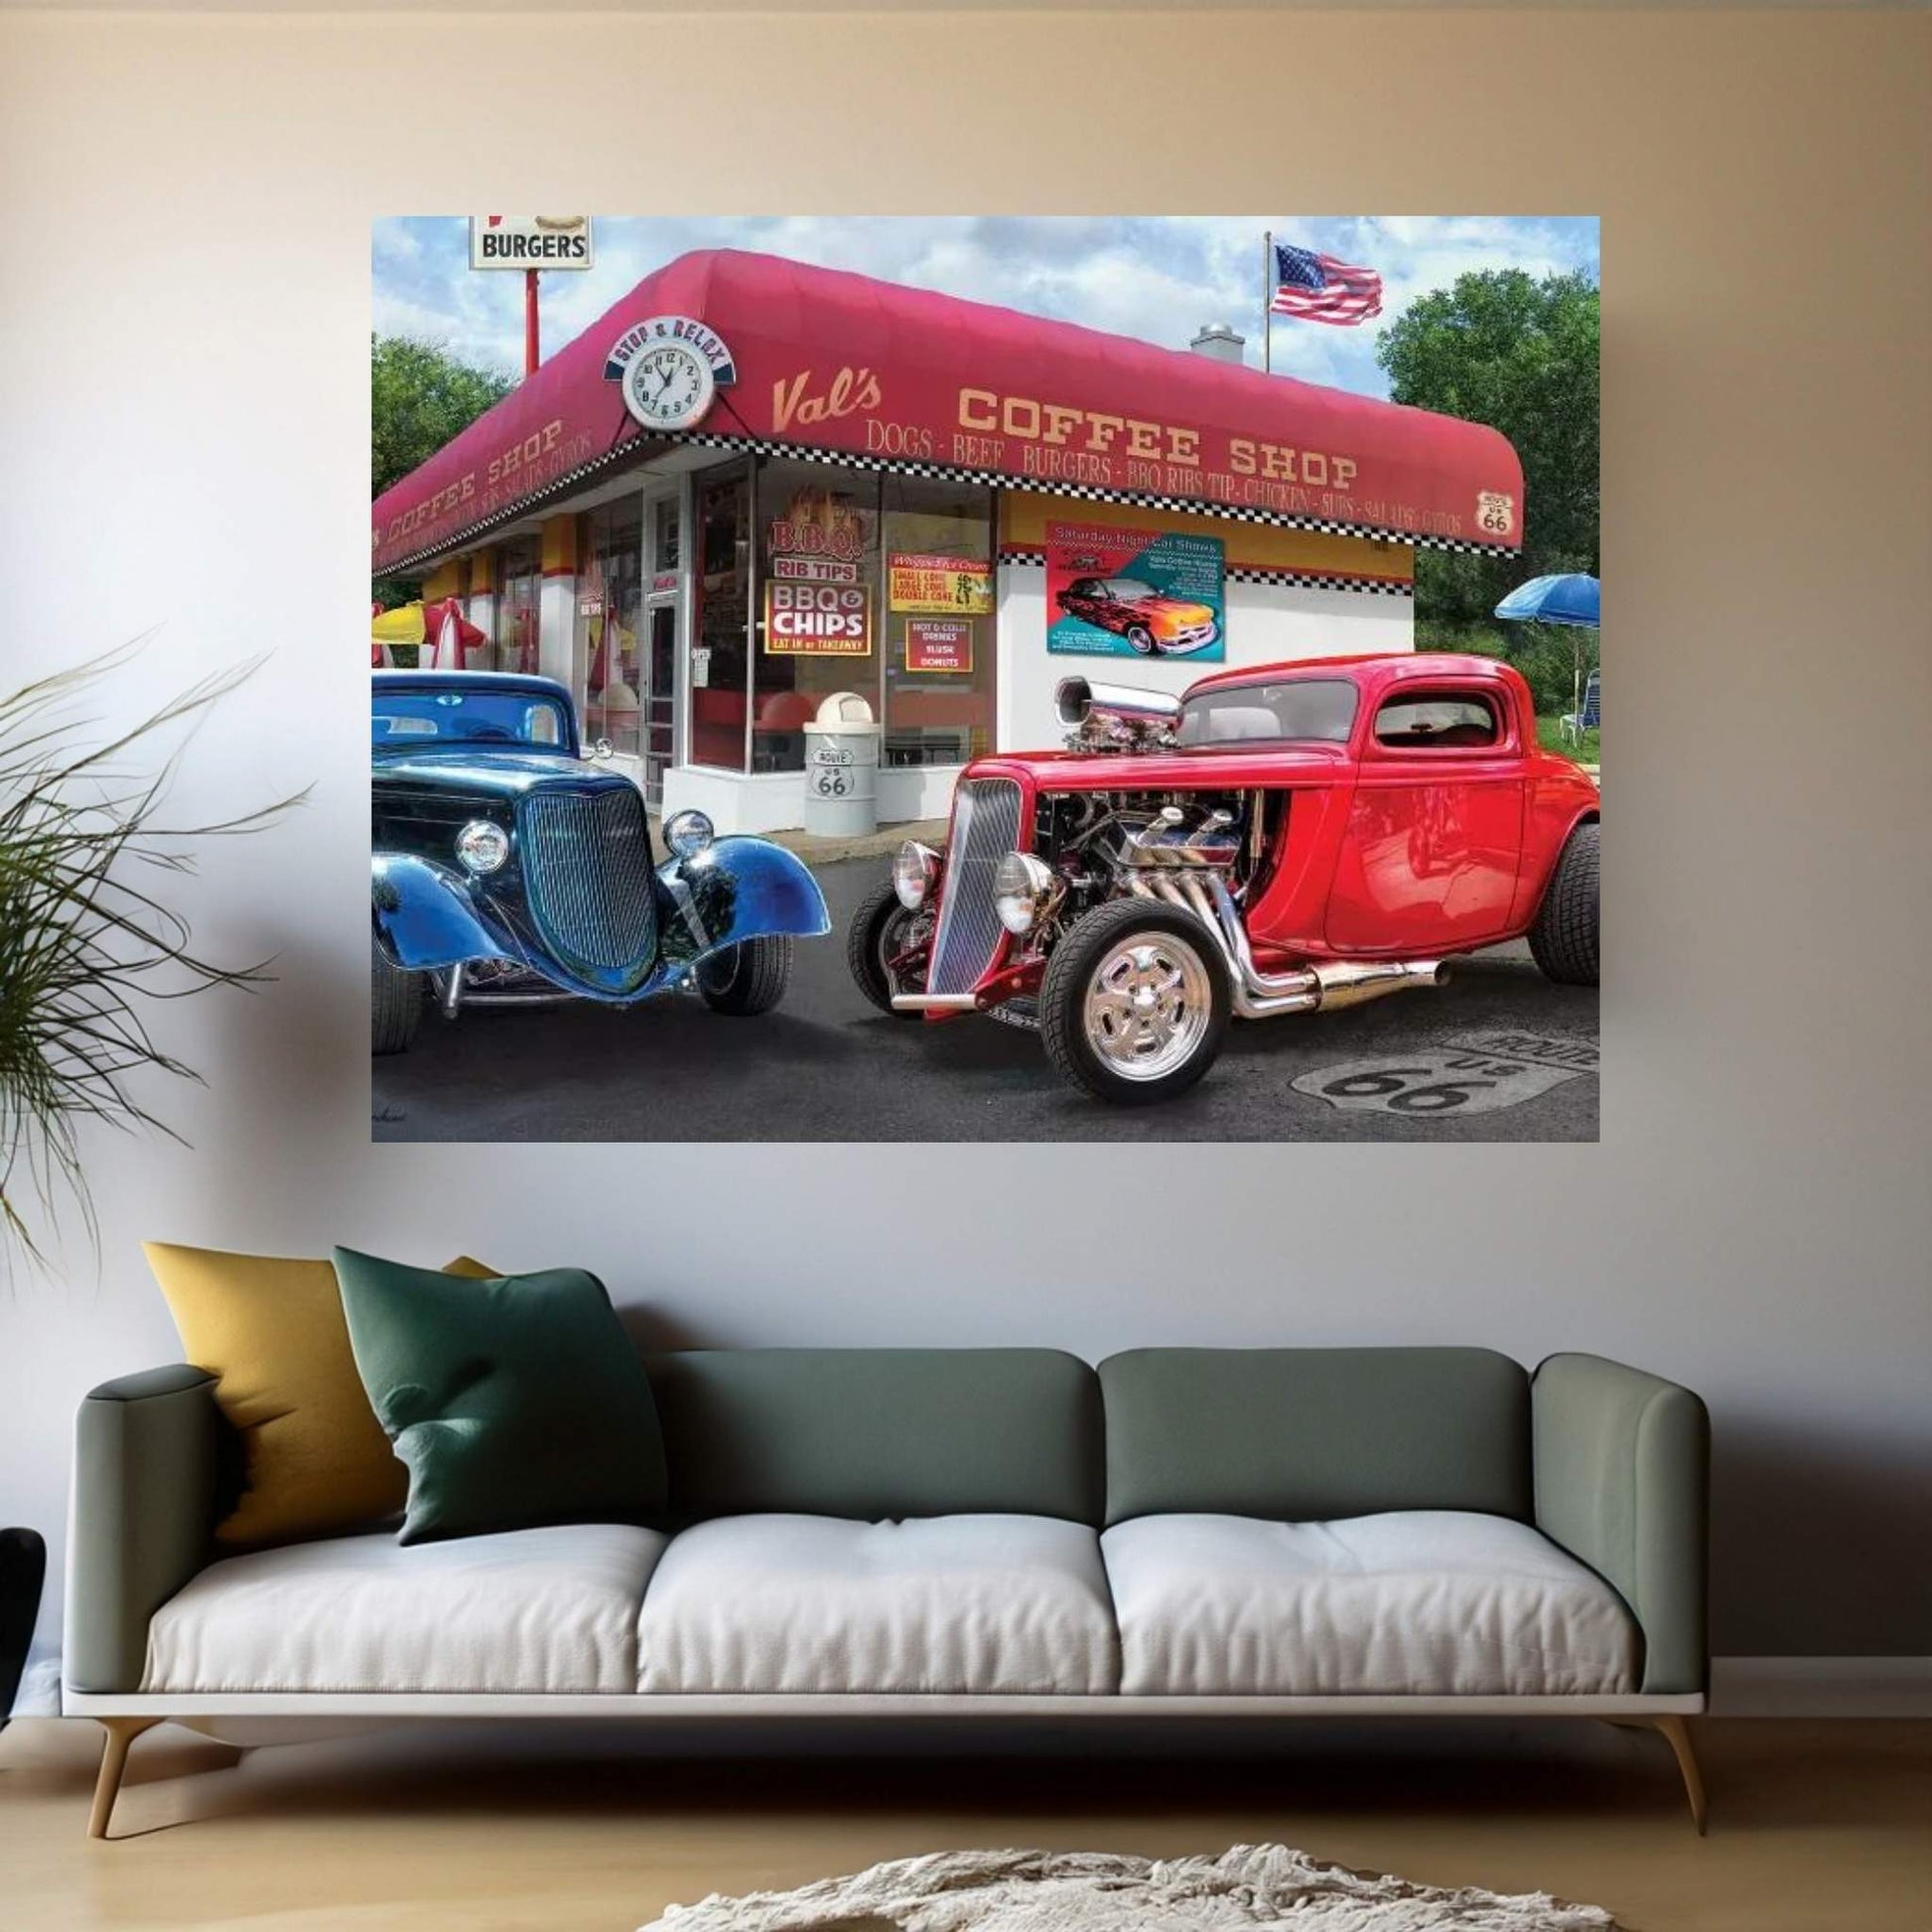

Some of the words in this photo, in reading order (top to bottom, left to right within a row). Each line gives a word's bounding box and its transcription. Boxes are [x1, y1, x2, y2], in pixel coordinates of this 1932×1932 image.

[483, 233, 586, 258] BURGERS
[614, 326, 648, 361] STOP
[773, 366, 882, 434] Val's
[866, 419, 932, 460] DOGS
[953, 434, 1005, 470] BEEF
[1023, 445, 1111, 484] BURGERS
[959, 387, 1200, 467] COFFEE
[1230, 438, 1357, 490] SHOP
[387, 472, 476, 542] COFFEE
[487, 418, 563, 483] SHOP
[1055, 526, 1113, 544] Saturday
[1483, 513, 1507, 532] 66
[775, 561, 809, 577] RIB
[813, 563, 855, 581] TIPS
[773, 586, 839, 612] BBQ
[772, 612, 864, 636] CHIPS
[818, 775, 846, 795] 66
[1321, 1068, 1497, 1111] 66
